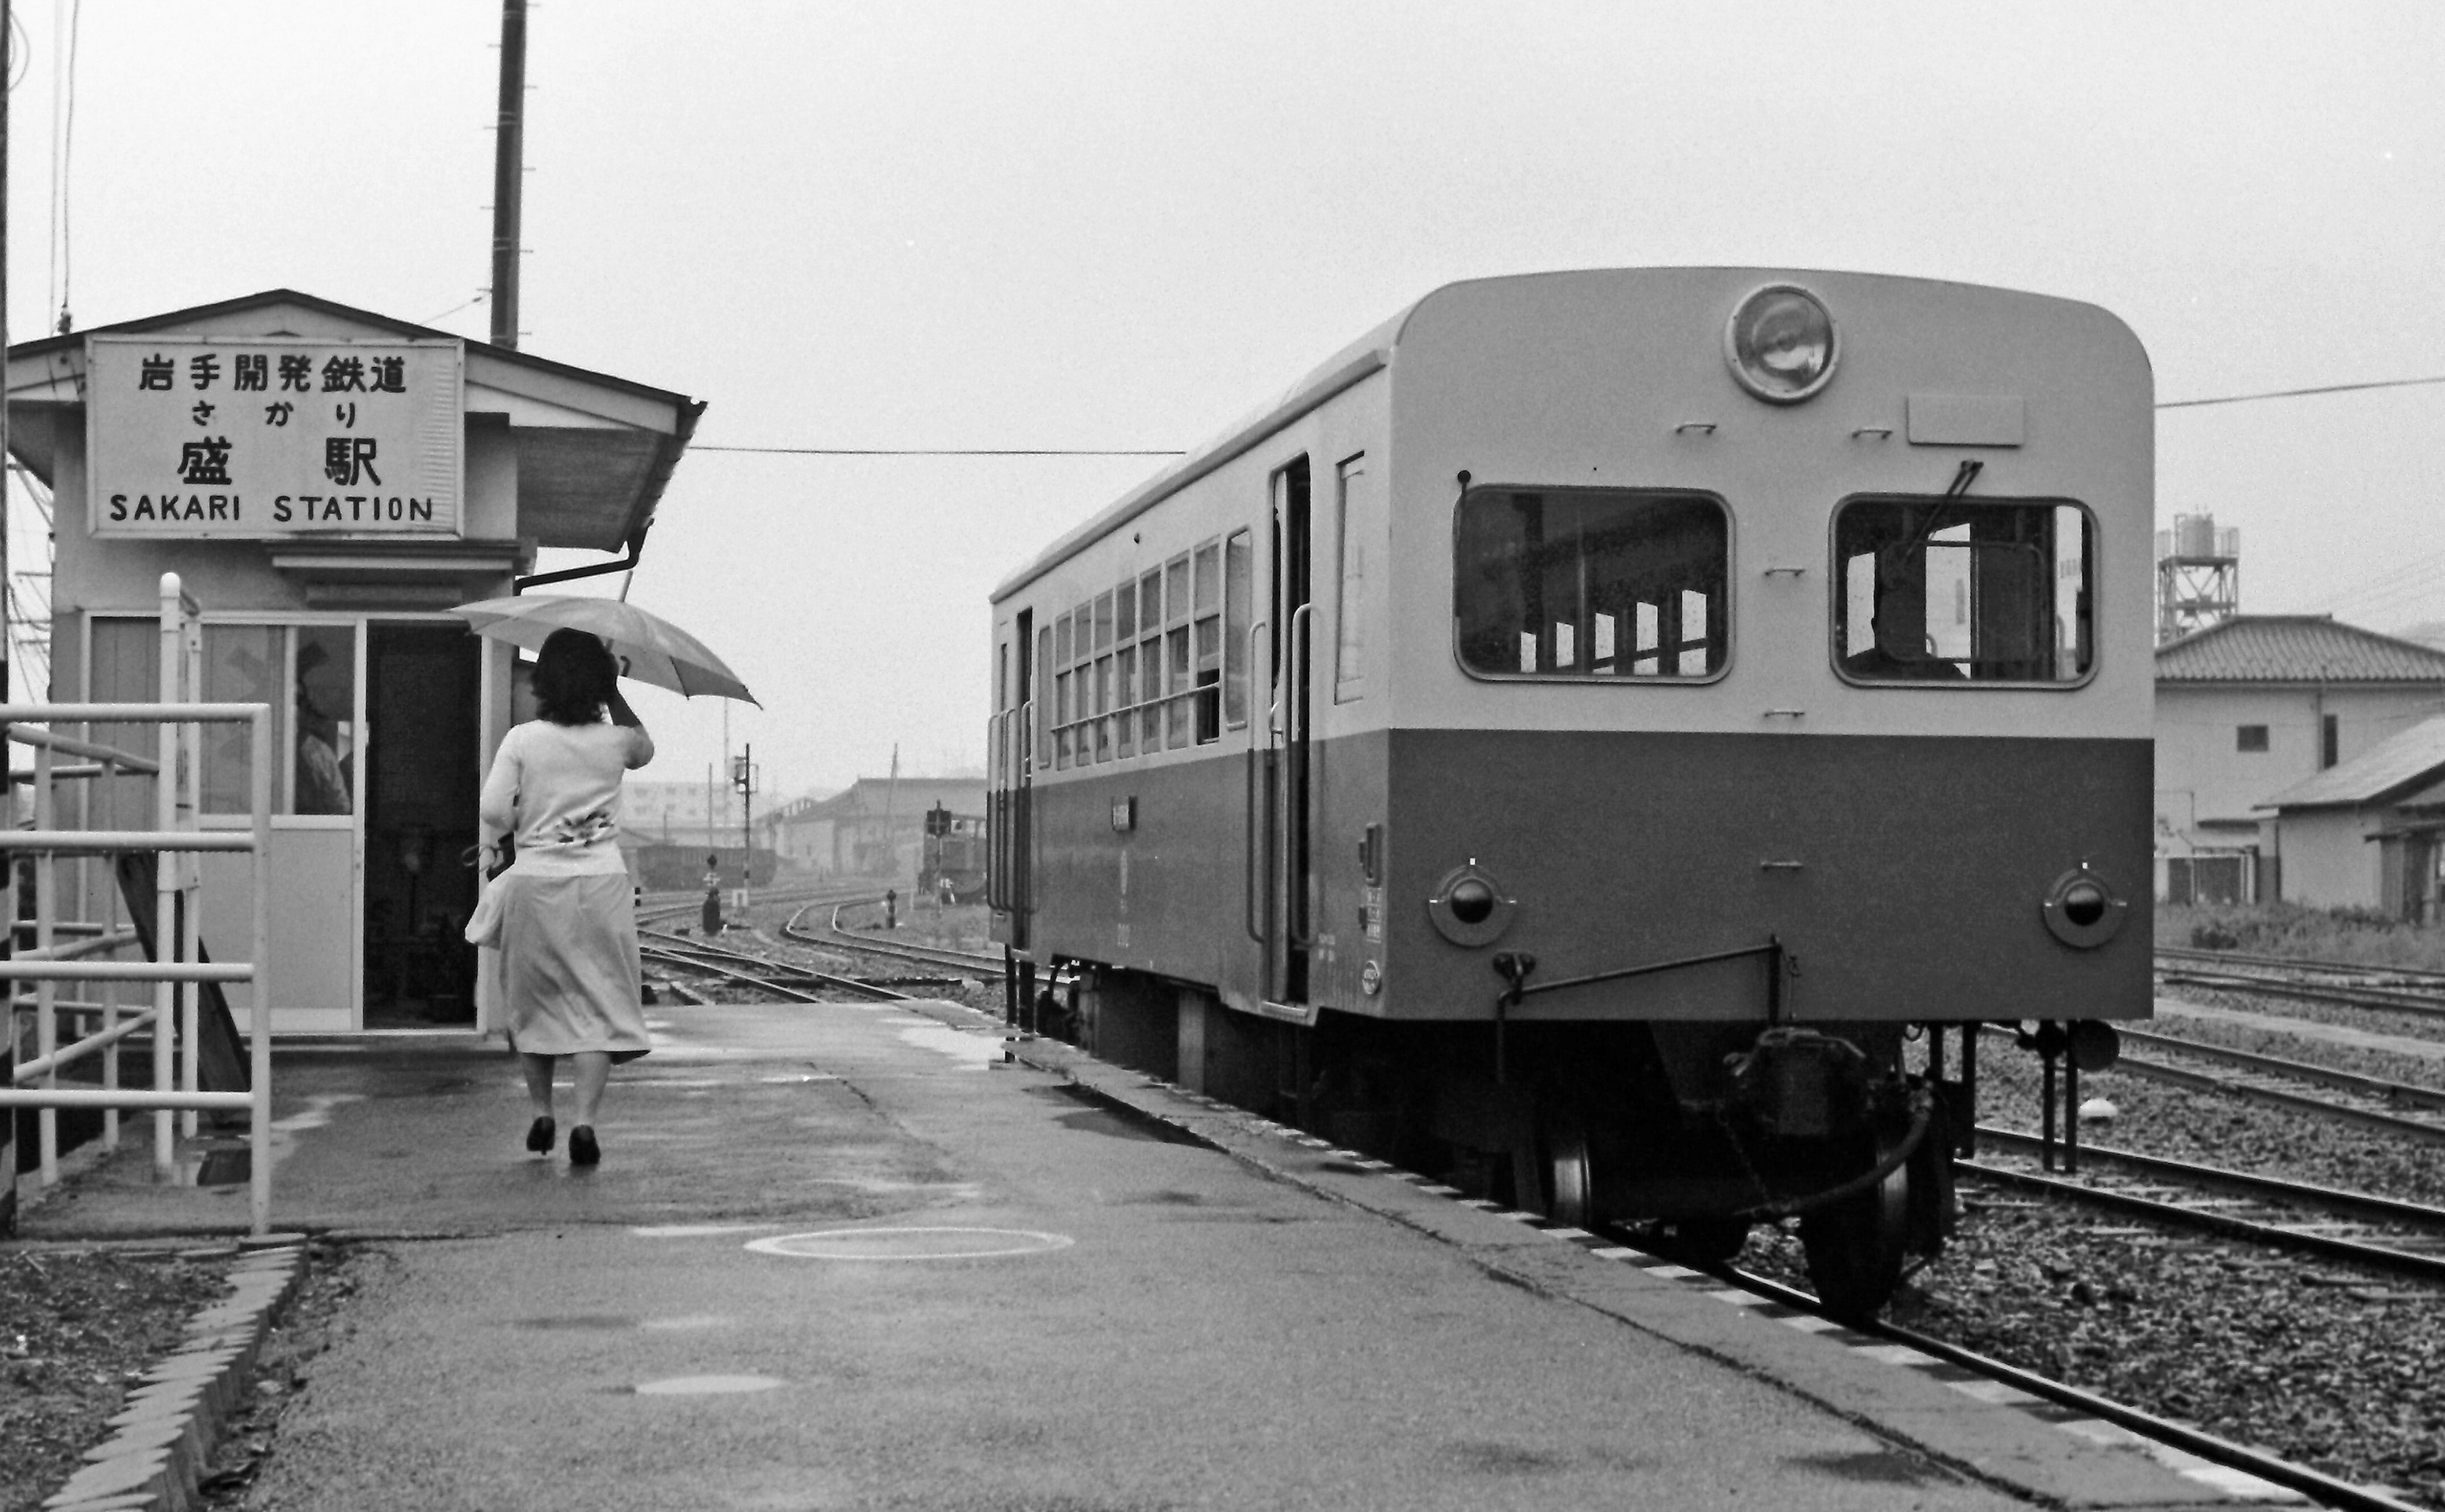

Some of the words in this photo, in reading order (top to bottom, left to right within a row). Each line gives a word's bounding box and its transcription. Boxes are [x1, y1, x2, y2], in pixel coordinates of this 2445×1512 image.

[138, 353, 406, 394] 岩手開発鉄道
[110, 494, 240, 522] SAKARI
[273, 495, 432, 523] STATION
